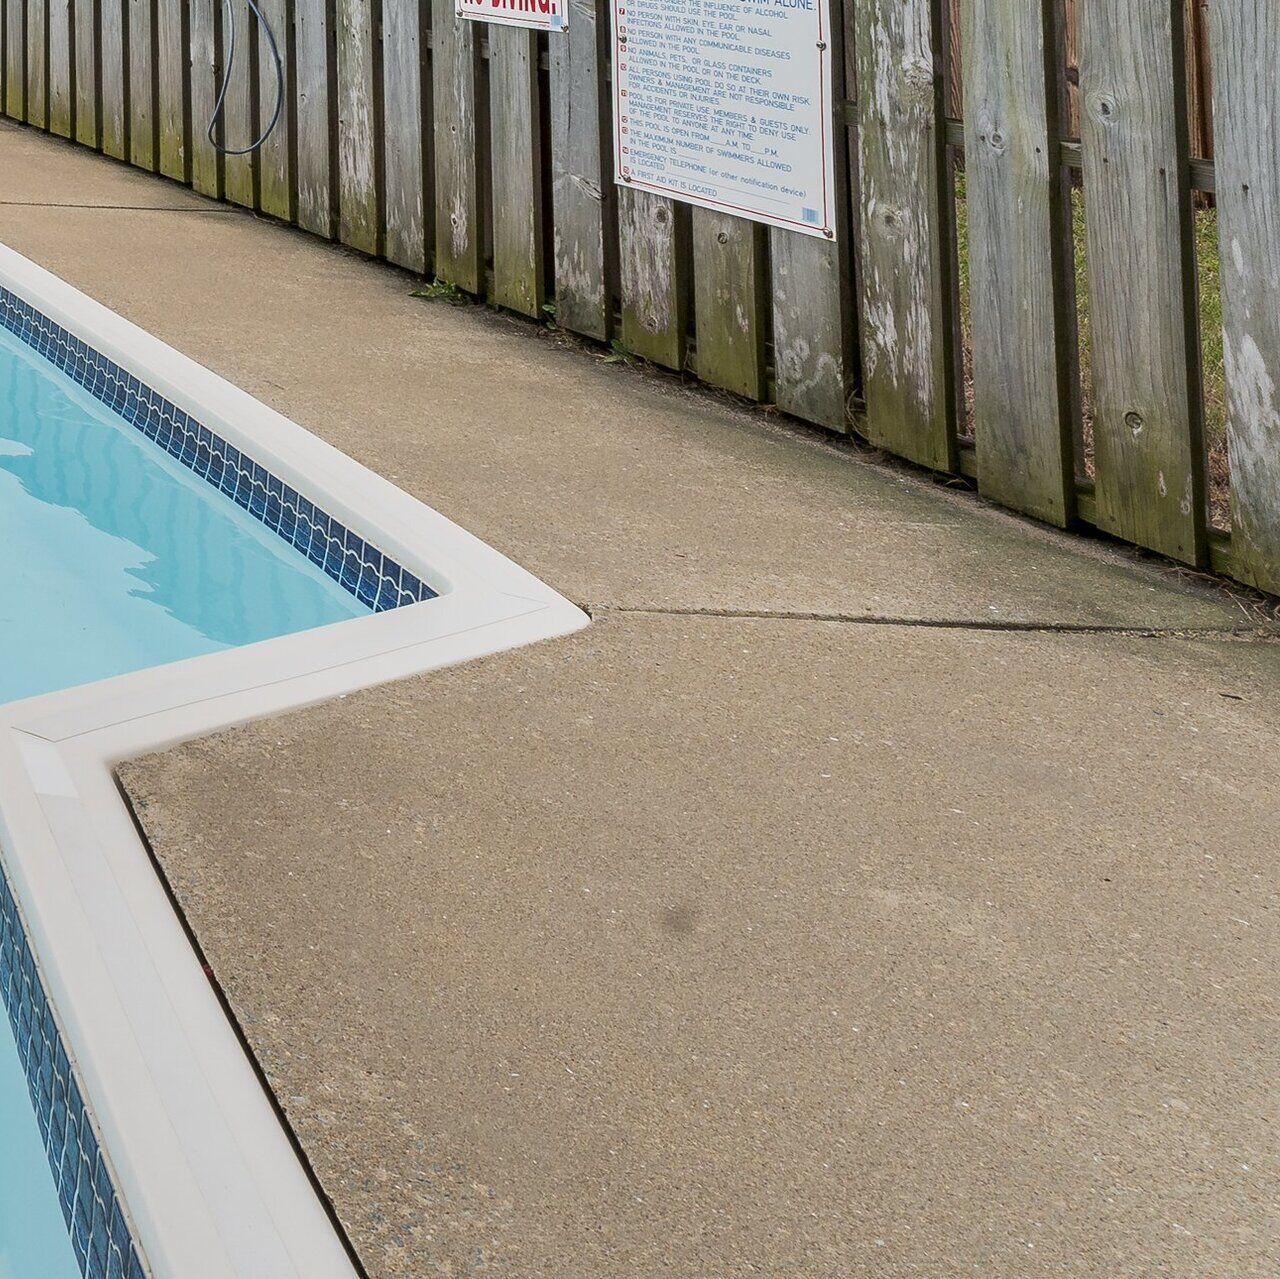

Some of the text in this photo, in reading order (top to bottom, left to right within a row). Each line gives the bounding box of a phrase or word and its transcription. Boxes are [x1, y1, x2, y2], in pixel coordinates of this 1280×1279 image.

[637, 1, 657, 9] DRUGS
[661, 4, 685, 13] SHOULD
[704, 2, 740, 12] INFLUENCE
[755, 8, 788, 19] ALCOHOL
[627, 18, 662, 28] INFECTIONS
[665, 24, 694, 33] ALLOWED
[638, 11, 662, 21] PERSON
[748, 27, 772, 37] NASAL
[628, 37, 657, 46] ALLOWED
[638, 30, 663, 39] PERSON
[699, 39, 752, 54] COMMUNICABLE
[755, 48, 791, 60] DISEASES
[629, 56, 657, 66] ALLOWED
[683, 65, 700, 74] POOL
[703, 59, 726, 69] GLASS
[729, 63, 772, 77] CONTAINERS
[628, 74, 655, 84] OWNERS
[666, 81, 710, 94] MANAGEMENT
[745, 96, 795, 111] RESPONSIBLE
[642, 68, 671, 79] PERSONS
[674, 74, 692, 83] USING
[695, 77, 712, 87] POOL
[750, 88, 770, 97] THEIR
[772, 92, 789, 101] OWN
[643, 84, 677, 97] ACCIDENTS
[629, 92, 644, 101] POOL
[669, 100, 694, 111] PRIVATE
[713, 109, 747, 123] MEMBERS
[760, 118, 788, 130] GUESTS
[629, 100, 671, 114] MANAGEMENT
[674, 108, 708, 122] RESERVES
[726, 119, 746, 129] RIGHT
[759, 127, 779, 137] DENY
[782, 132, 796, 141] USE
[645, 122, 662, 131] POOL
[672, 127, 689, 137] OPEN
[654, 113, 669, 122] POOL
[682, 119, 708, 130] ANYONE
[721, 127, 736, 136] ANY
[644, 133, 673, 145] MAXIMUM
[676, 140, 703, 152] NUMBER
[717, 148, 754, 163] SWIMMERS
[757, 159, 792, 173] ALLOWED
[652, 144, 668, 152] POOL
[630, 149, 667, 163] EMERGENCY
[670, 158, 706, 173] TELEPHONE
[721, 172, 737, 181] other
[741, 175, 778, 191] notification
[780, 186, 807, 198] device)
[638, 159, 665, 170] LOCATED
[638, 170, 654, 180] FIRST
[689, 183, 717, 196] LOCATED
